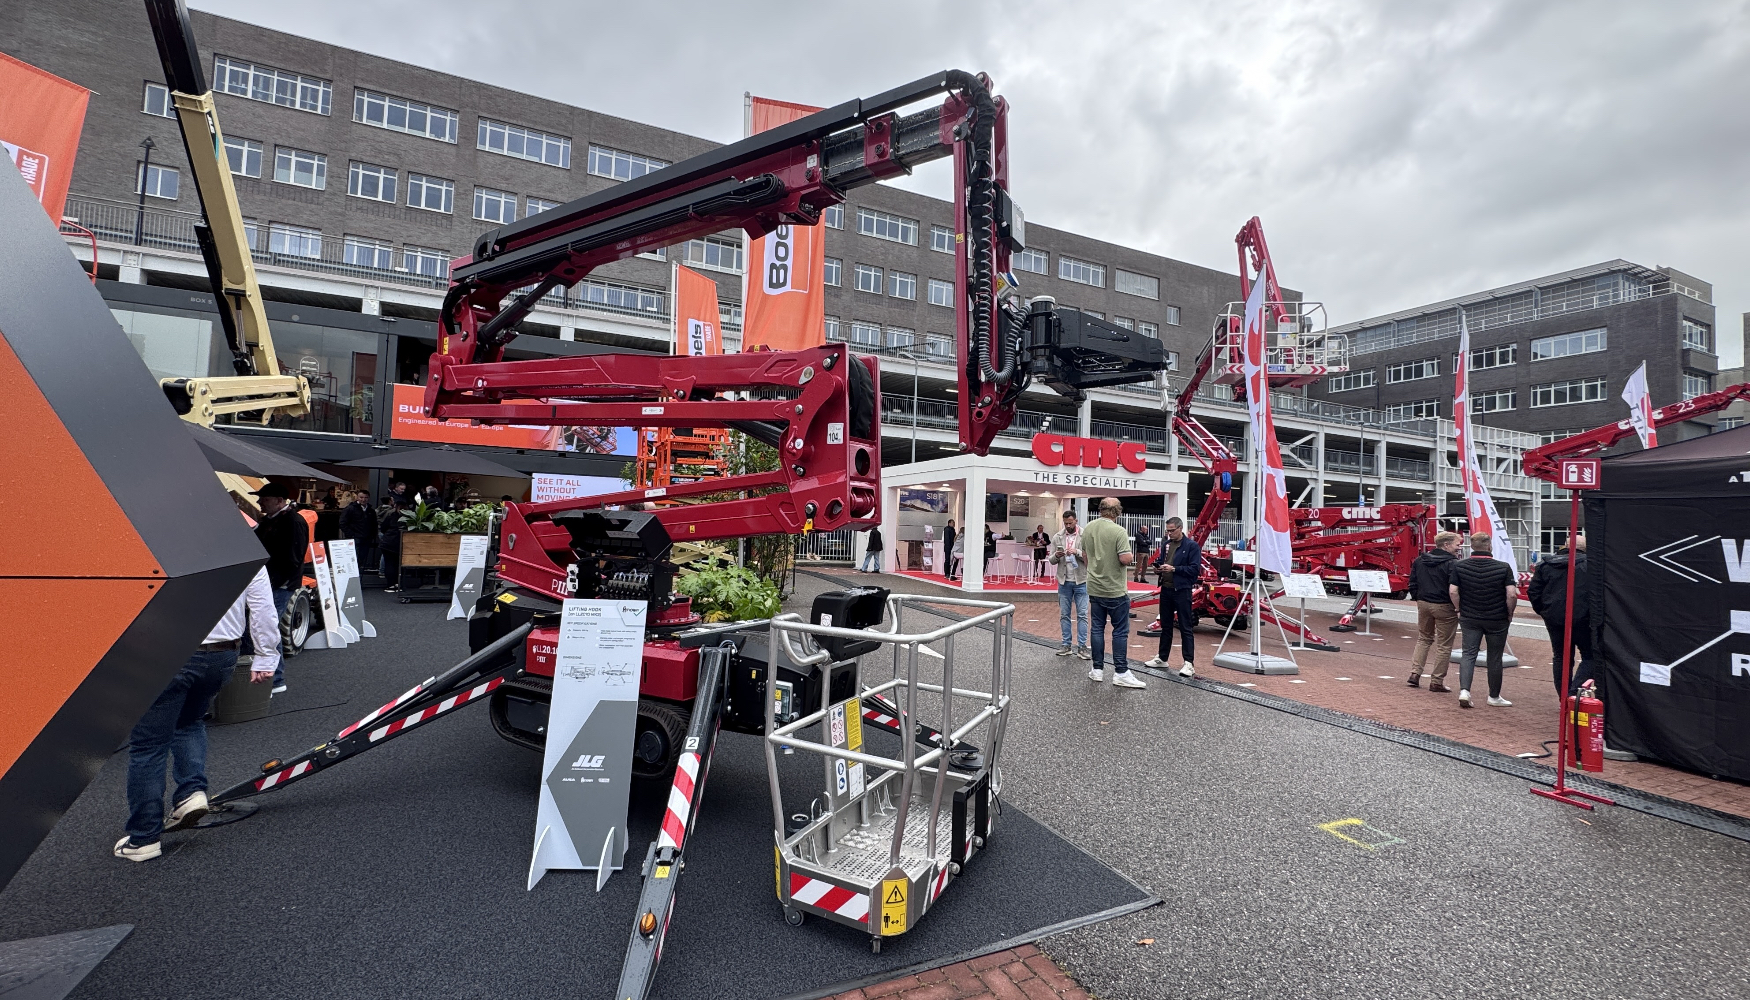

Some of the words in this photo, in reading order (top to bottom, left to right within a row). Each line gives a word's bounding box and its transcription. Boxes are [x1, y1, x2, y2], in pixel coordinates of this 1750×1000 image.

[190, 296, 206, 304] BOX
[398, 417, 437, 426] Engineered
[445, 420, 469, 429] Europe
[537, 477, 554, 485] SEE
[565, 479, 581, 487] ALL
[1033, 472, 1058, 483] THE
[1065, 474, 1138, 489] SPECIALIFT
[536, 486, 577, 494] WITHOUT
[926, 492, 938, 500] S18
[1303, 509, 1320, 519] S20
[1731, 652, 1750, 677] R
[688, 738, 697, 748] 2
[571, 754, 606, 768] JLG
